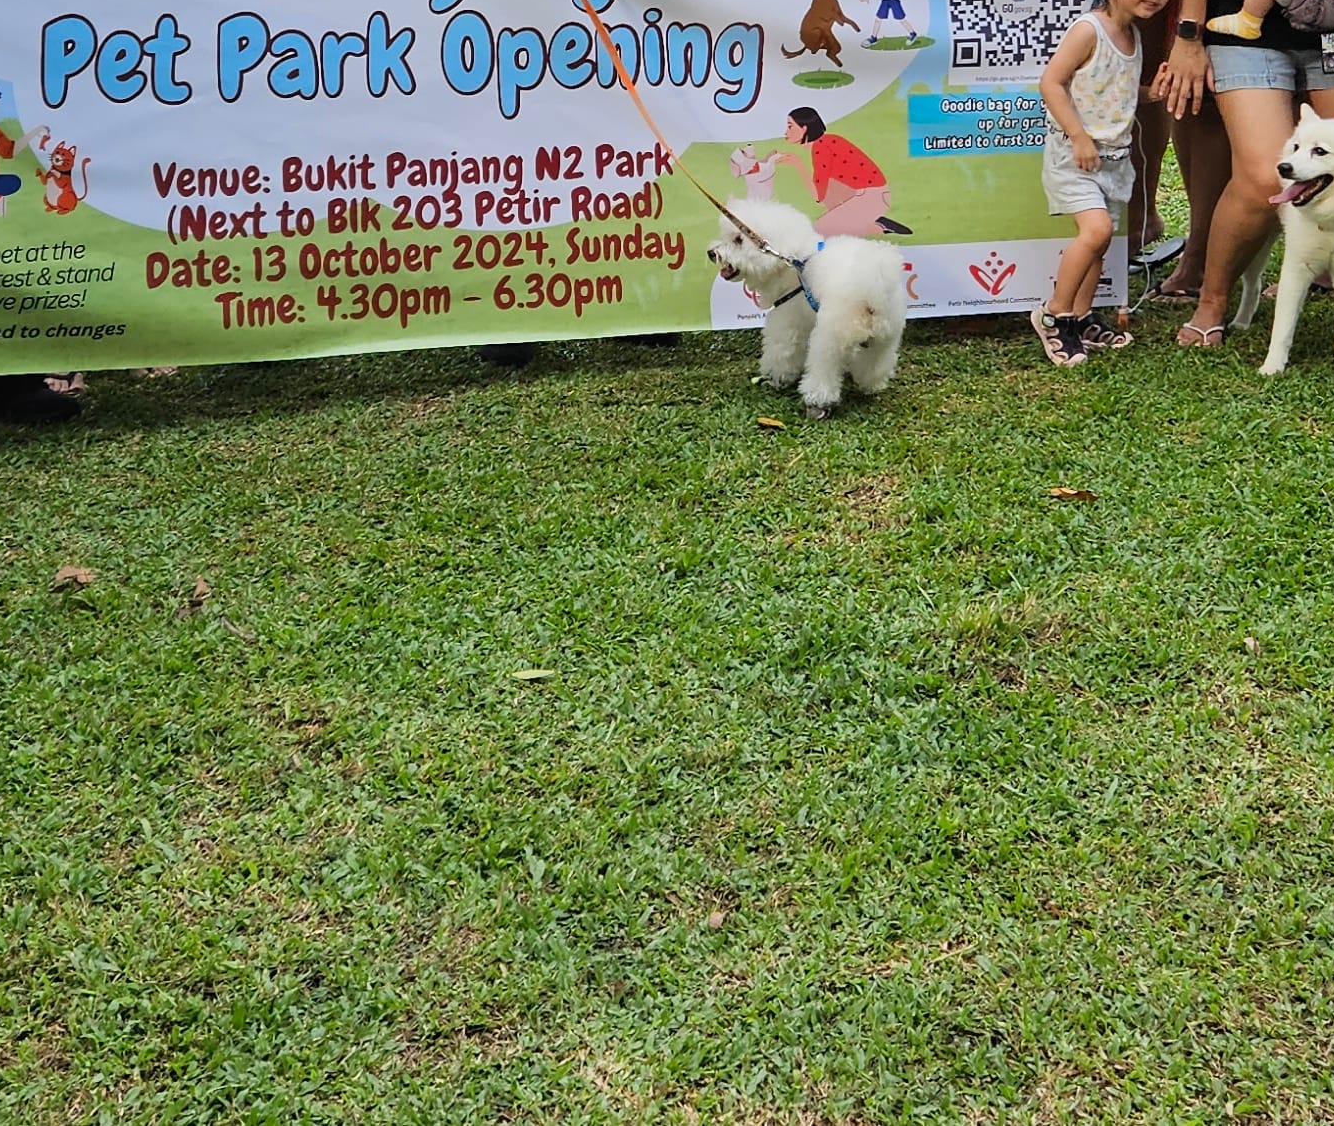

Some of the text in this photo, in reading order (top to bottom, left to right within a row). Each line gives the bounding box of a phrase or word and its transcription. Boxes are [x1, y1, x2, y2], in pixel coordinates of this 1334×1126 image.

[40, 7, 765, 120] Pet Park Opening
[941, 98, 984, 113] Goodie
[987, 97, 1011, 115] bag
[1016, 96, 1037, 111] for
[978, 119, 994, 132] up
[998, 116, 1019, 130] for
[924, 136, 973, 150] Limited
[976, 135, 989, 148] to
[993, 133, 1023, 147] first
[152, 142, 674, 198] Venue: Bukit Panjang N2 Park
[167, 181, 663, 245] (Next to Blk 203 Petir Road)
[26, 244, 49, 262] at
[52, 241, 86, 260] the
[146, 223, 685, 289] Date: 13 October 2024, Sunday
[37, 267, 52, 286] &
[55, 262, 116, 285] stand
[18, 289, 87, 314] prizes!
[214, 291, 306, 330] Time:
[317, 283, 451, 329] 4.30pm
[493, 273, 623, 318] 6.30pm
[20, 326, 40, 339] to
[45, 323, 127, 340] changes
